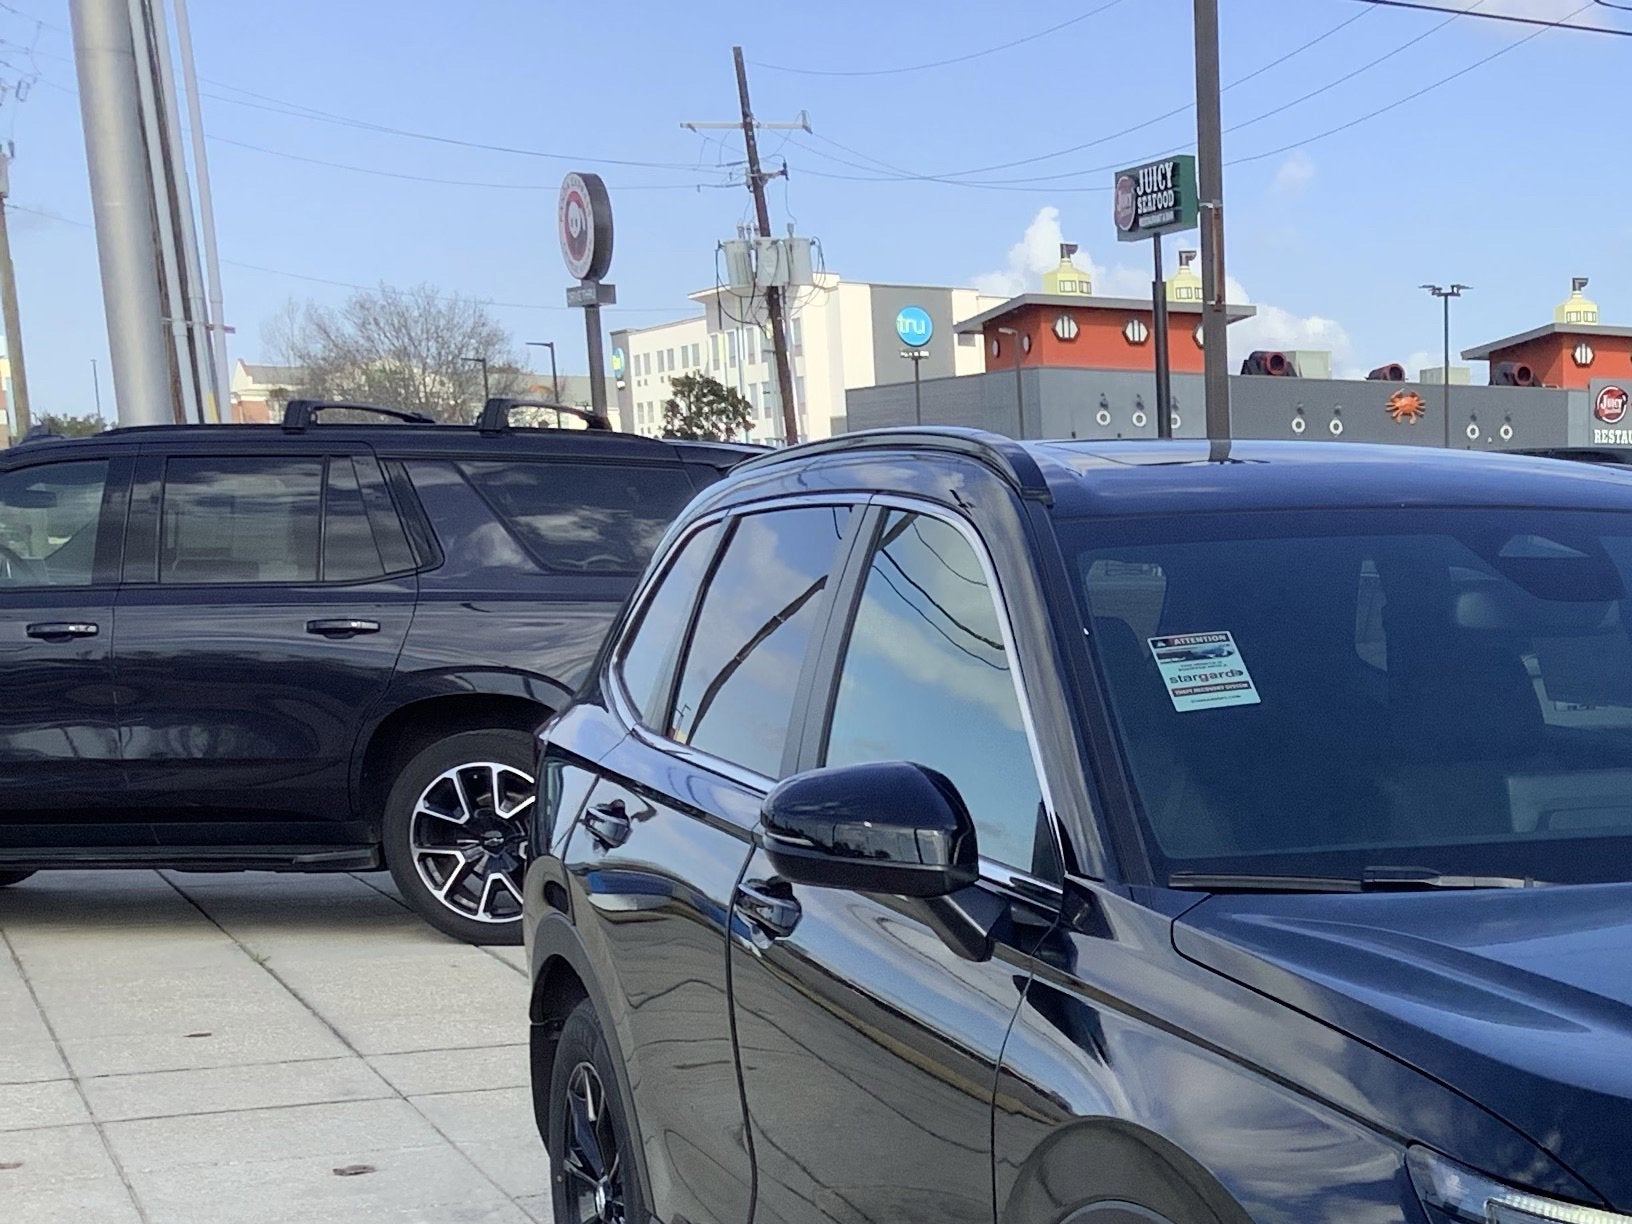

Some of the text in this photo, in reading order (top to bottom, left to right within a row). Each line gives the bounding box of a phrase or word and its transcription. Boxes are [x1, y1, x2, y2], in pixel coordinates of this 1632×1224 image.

[1136, 161, 1173, 195] JUICY
[1137, 189, 1174, 214] SEAFOOD
[898, 313, 926, 335] tru
[1173, 634, 1227, 646] ATTENTION
[1169, 669, 1237, 684] stargard
